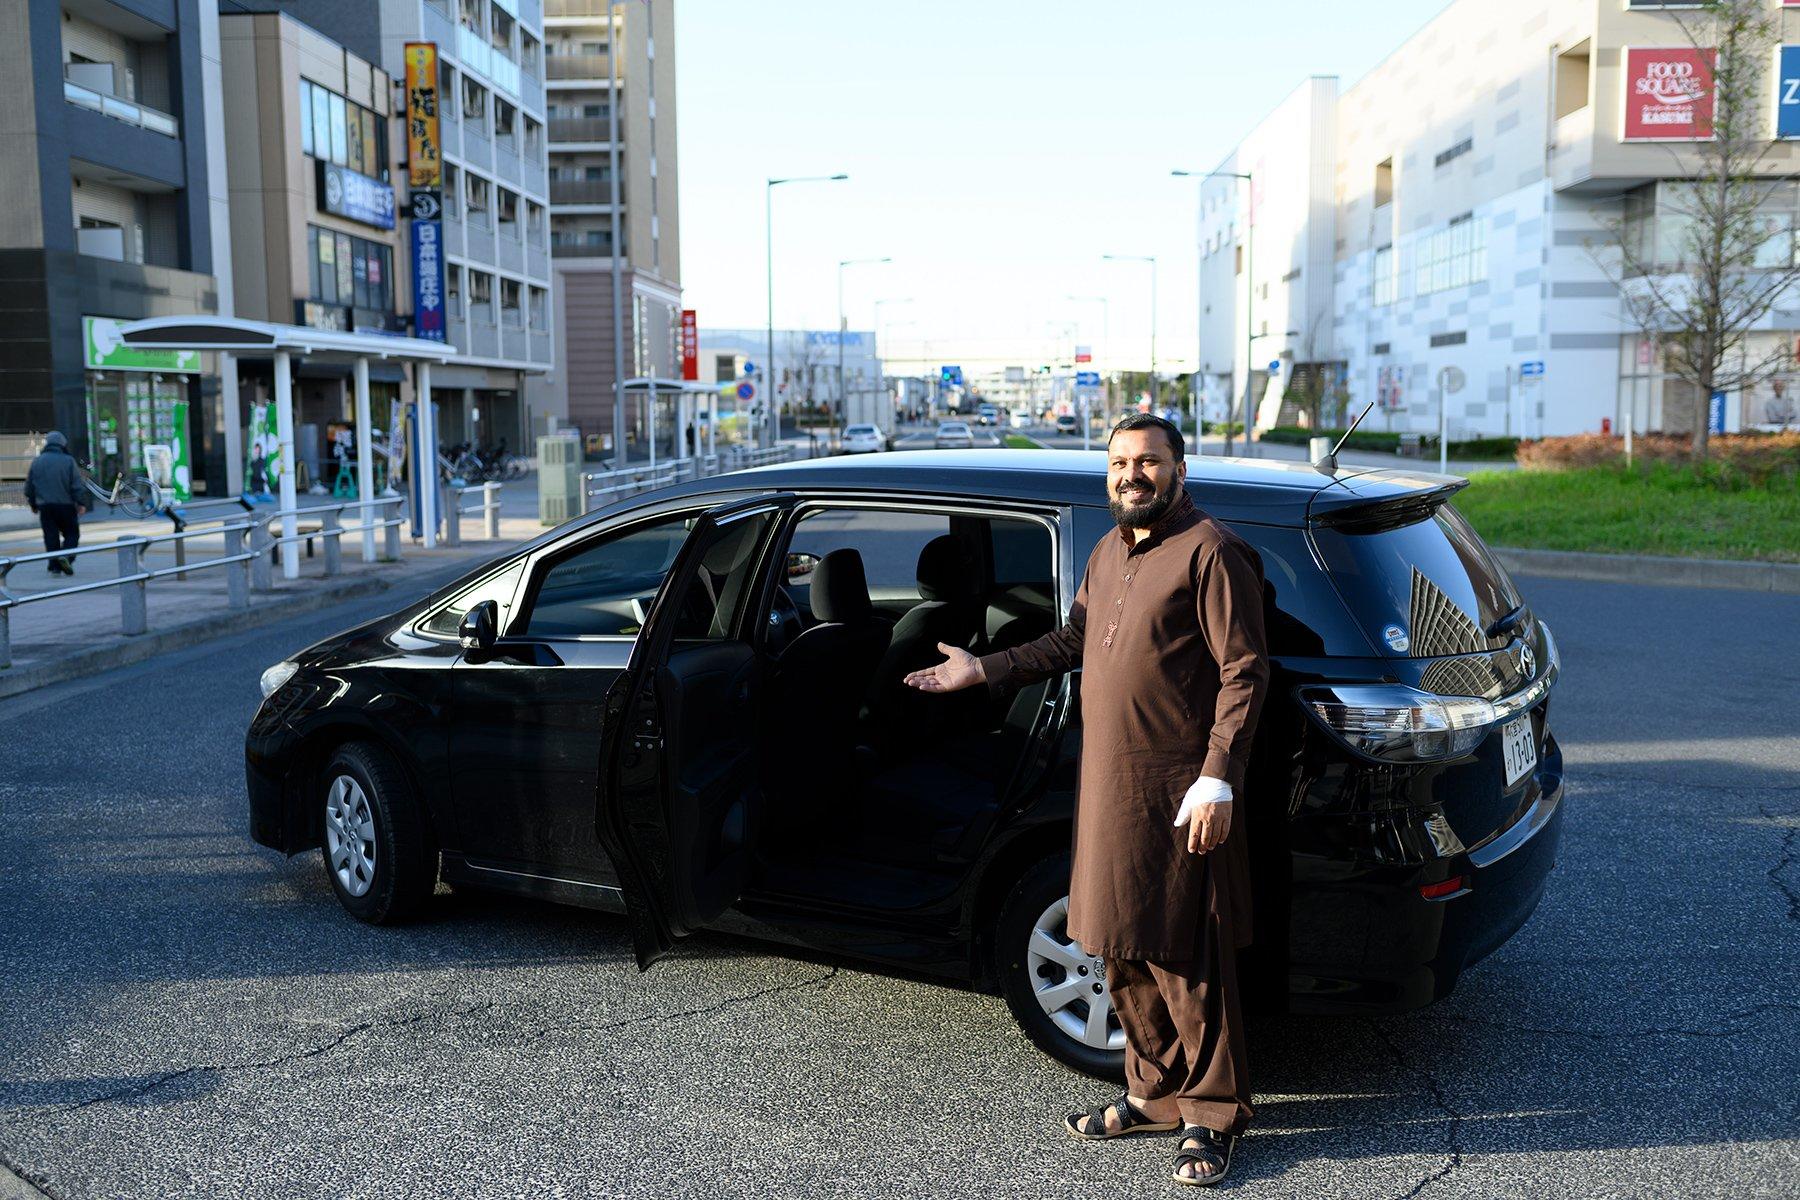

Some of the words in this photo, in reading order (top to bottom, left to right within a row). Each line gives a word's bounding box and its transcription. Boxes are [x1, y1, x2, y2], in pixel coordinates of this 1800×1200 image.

[1648, 62, 1693, 78] FOOD
[1636, 77, 1701, 94] SQUARE
[1511, 731, 1535, 775] 13-03
